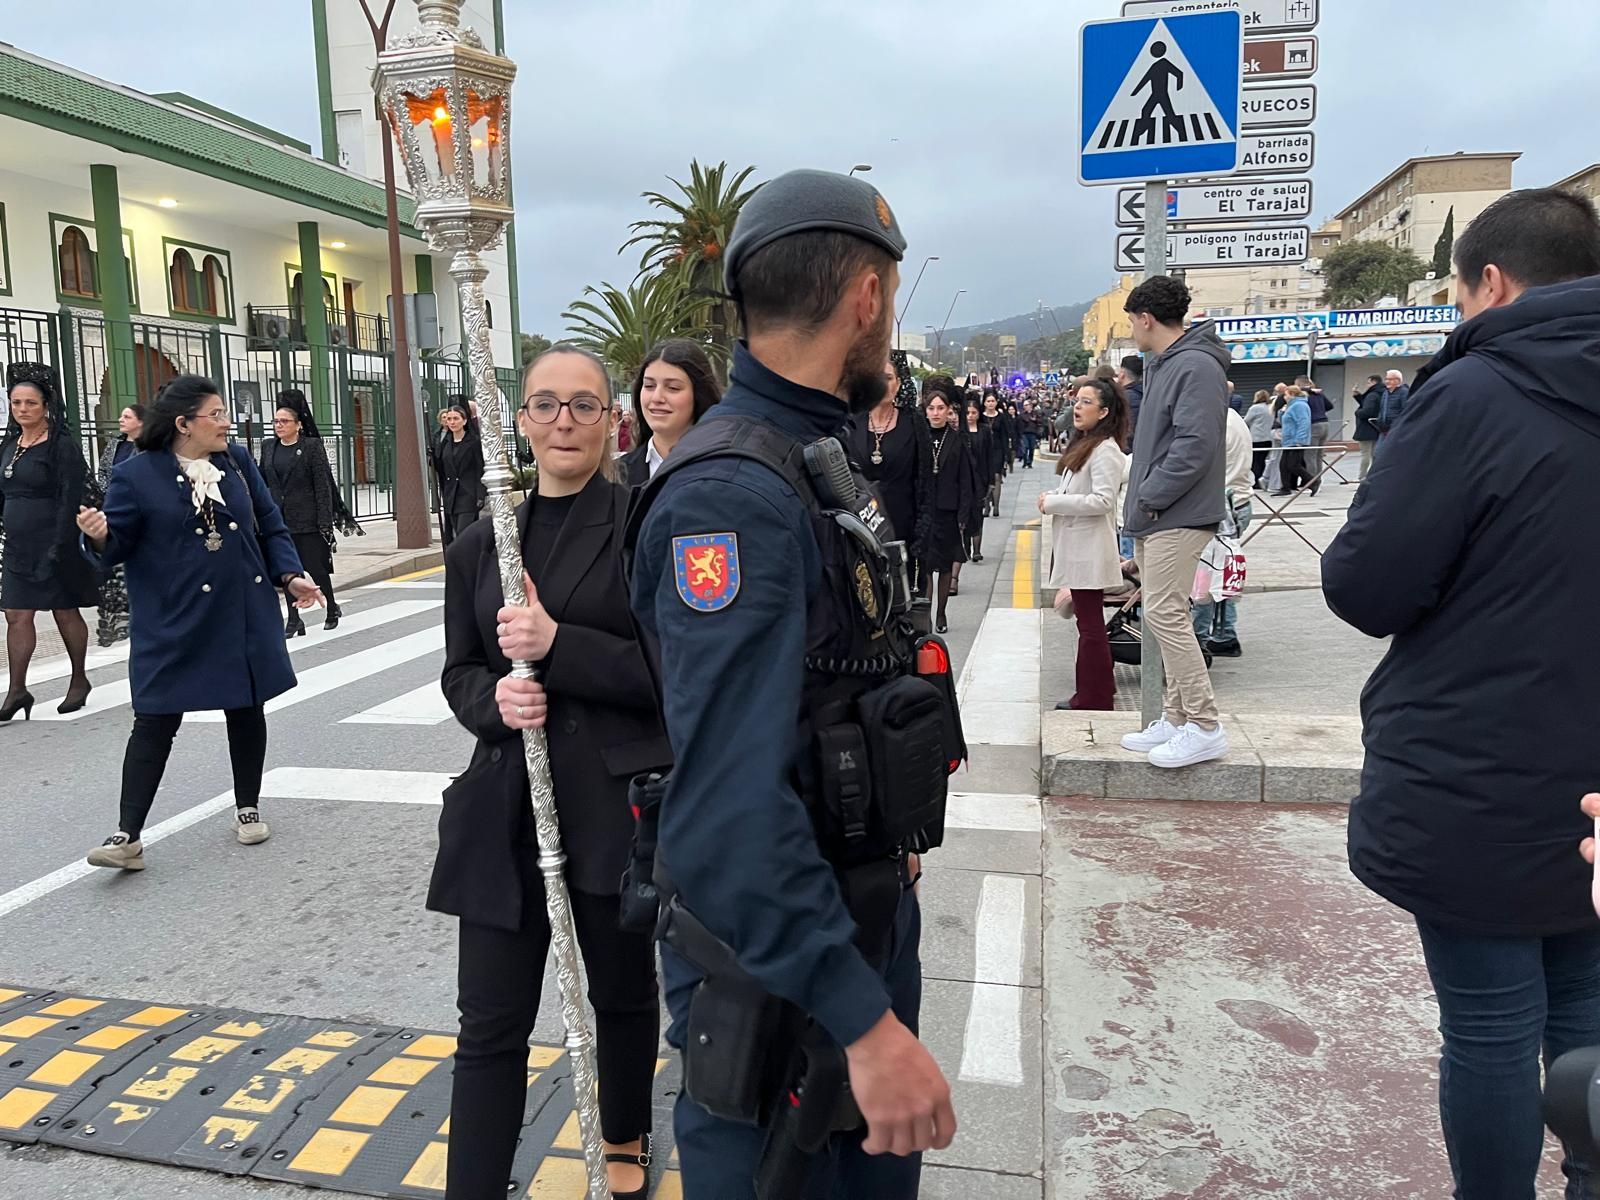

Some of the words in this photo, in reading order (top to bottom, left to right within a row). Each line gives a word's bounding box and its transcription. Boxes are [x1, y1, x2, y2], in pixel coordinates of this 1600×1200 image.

[1258, 137, 1308, 149] barriada
[1242, 152, 1308, 166] Alfonso
[1204, 188, 1242, 198] centro
[1250, 186, 1265, 196] de
[1273, 184, 1307, 195] salud
[1218, 199, 1235, 213] El
[1246, 196, 1306, 212] Tarajal
[1244, 230, 1304, 242] industrial
[1217, 246, 1233, 259] El
[1244, 243, 1304, 259] Tarajal
